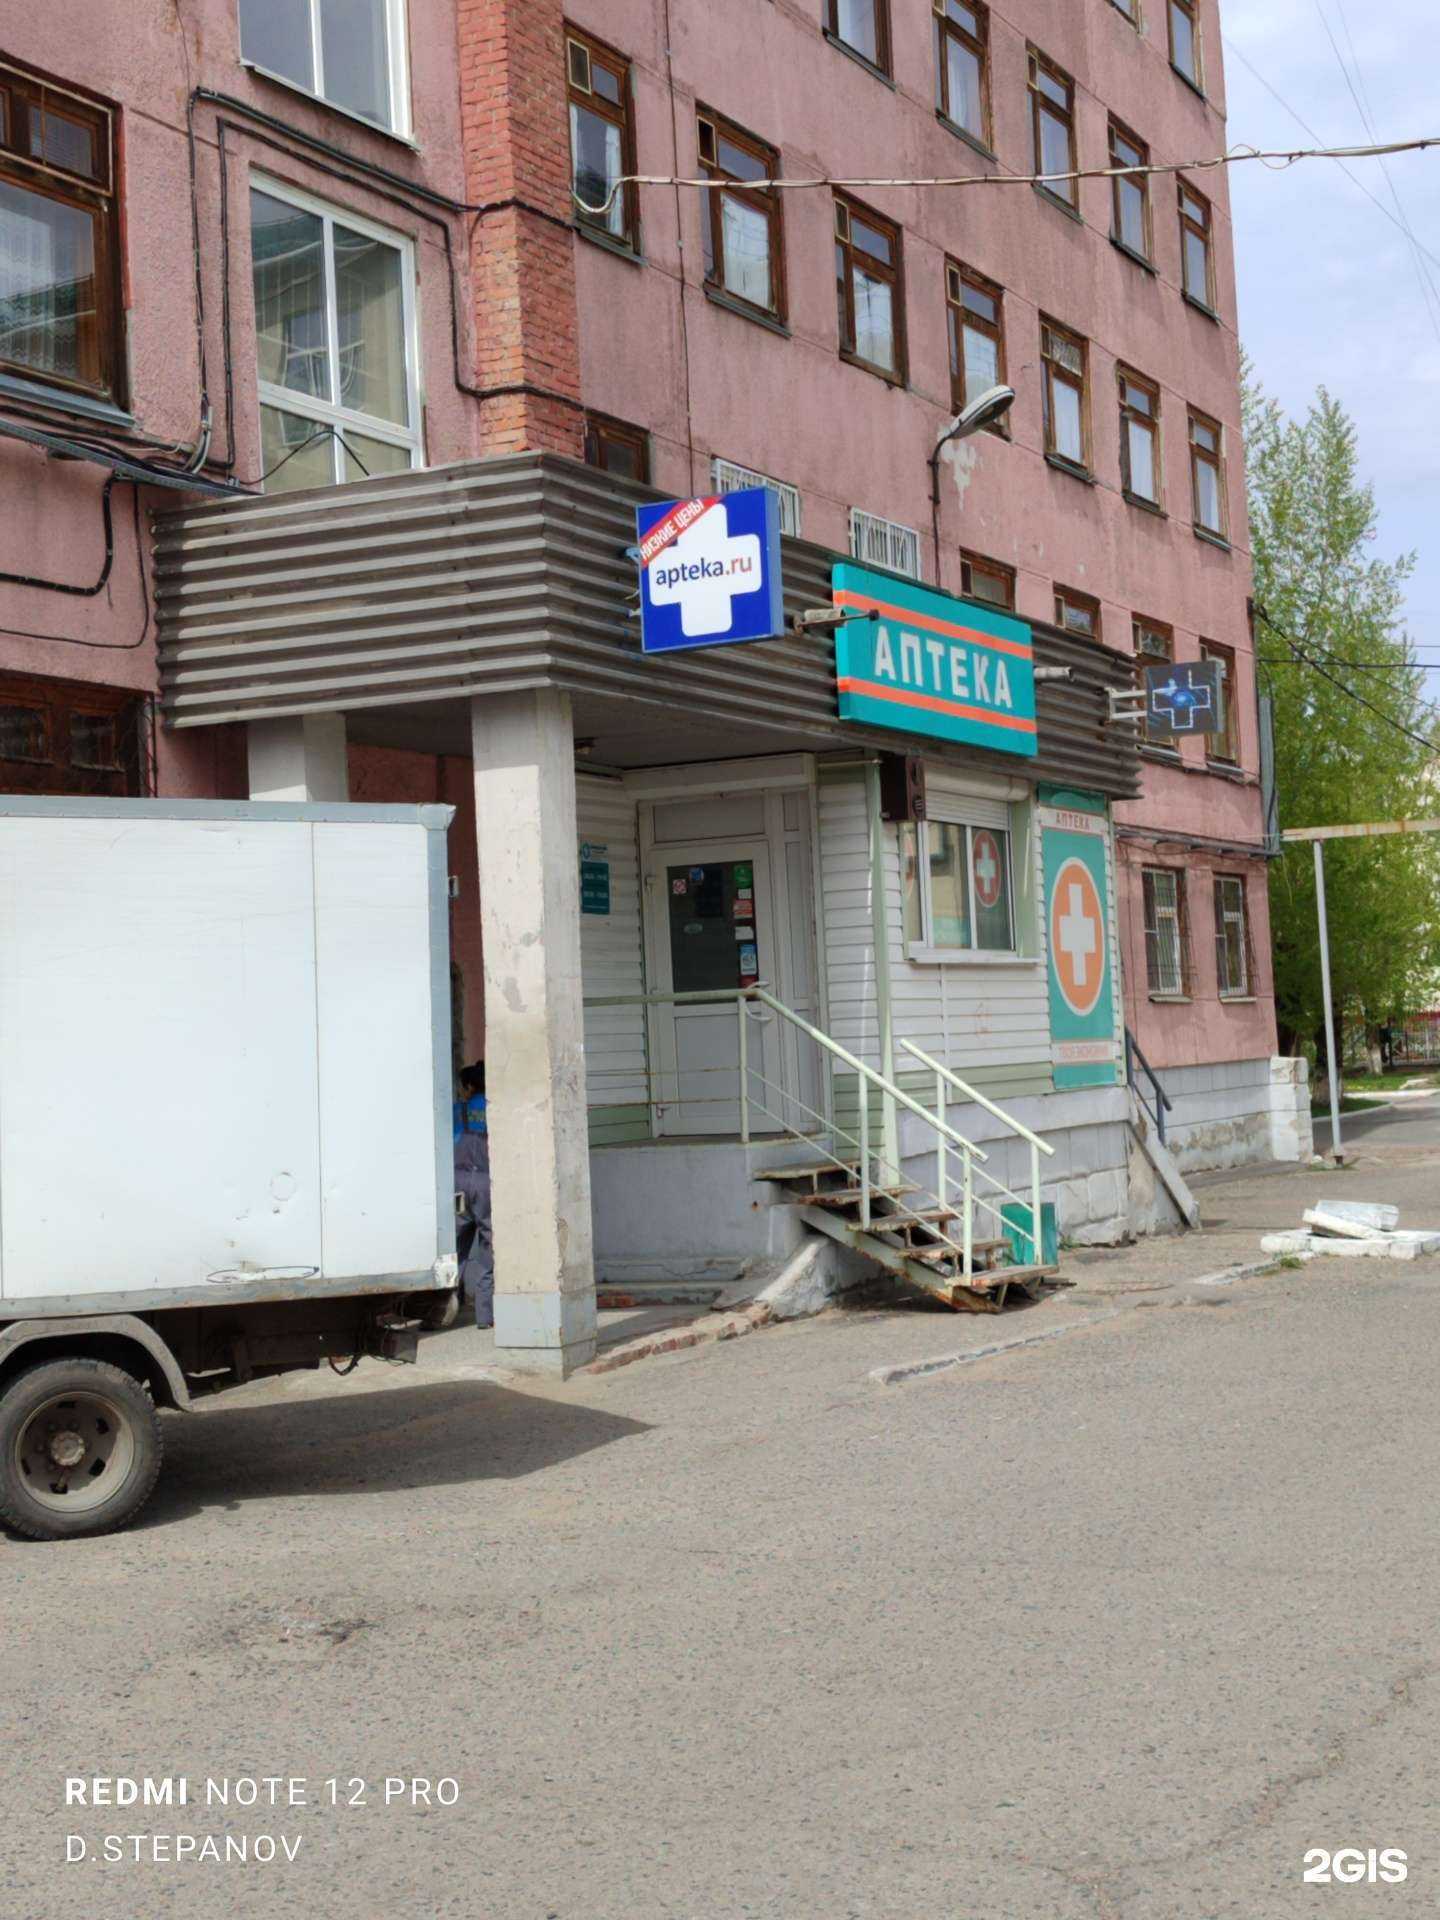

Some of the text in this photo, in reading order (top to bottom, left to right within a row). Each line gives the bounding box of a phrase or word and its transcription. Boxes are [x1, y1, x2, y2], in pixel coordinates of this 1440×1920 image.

[640, 498, 704, 560] НИЗКИЕ ЦЕНЫ
[656, 557, 752, 588] apteka.ru
[874, 625, 1013, 709] АПТЕКА
[1056, 812, 1090, 830] АПТЕКА
